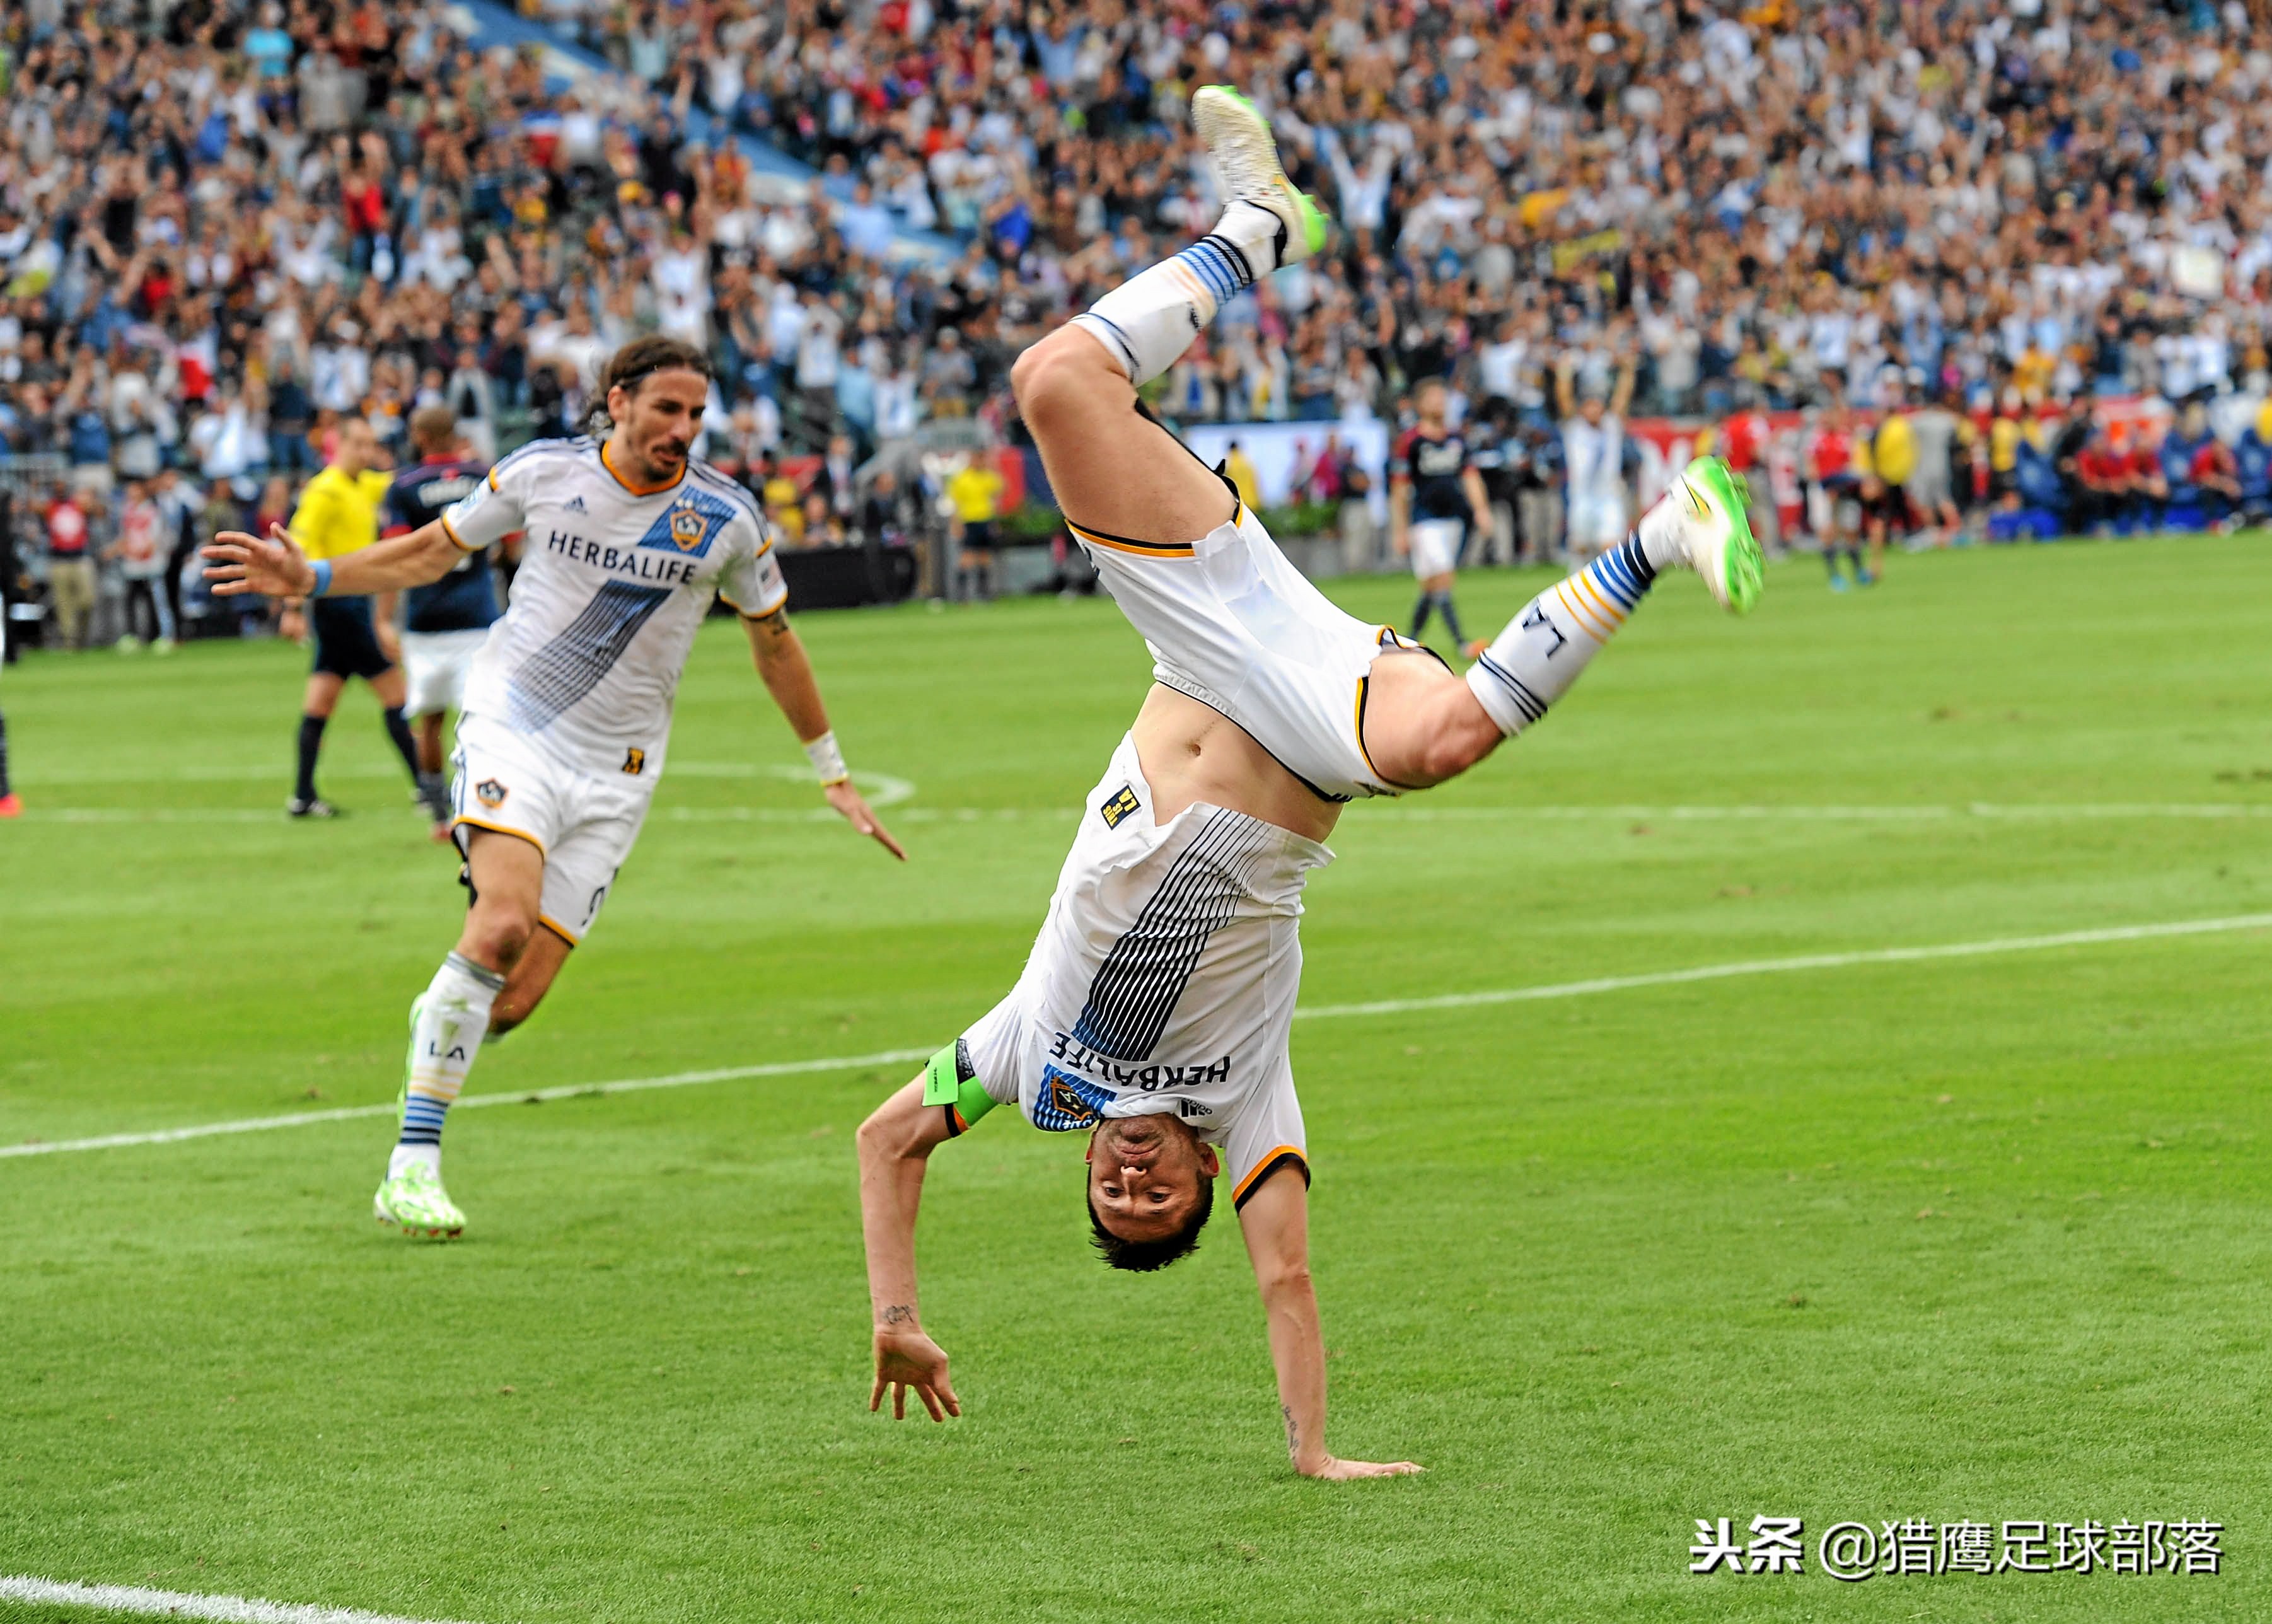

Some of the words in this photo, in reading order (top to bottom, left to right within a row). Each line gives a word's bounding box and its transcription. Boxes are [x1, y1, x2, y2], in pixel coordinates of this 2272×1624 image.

[548, 530, 696, 584] HERBALIFE
[1522, 598, 1567, 660] LA
[1112, 803, 1123, 815] IS
[1118, 788, 1137, 812] LA
[1103, 805, 1118, 826] THIS
[430, 1041, 465, 1061] LA
[1049, 1031, 1230, 1091] HERBALIFE
[1058, 1090, 1083, 1105] LA
